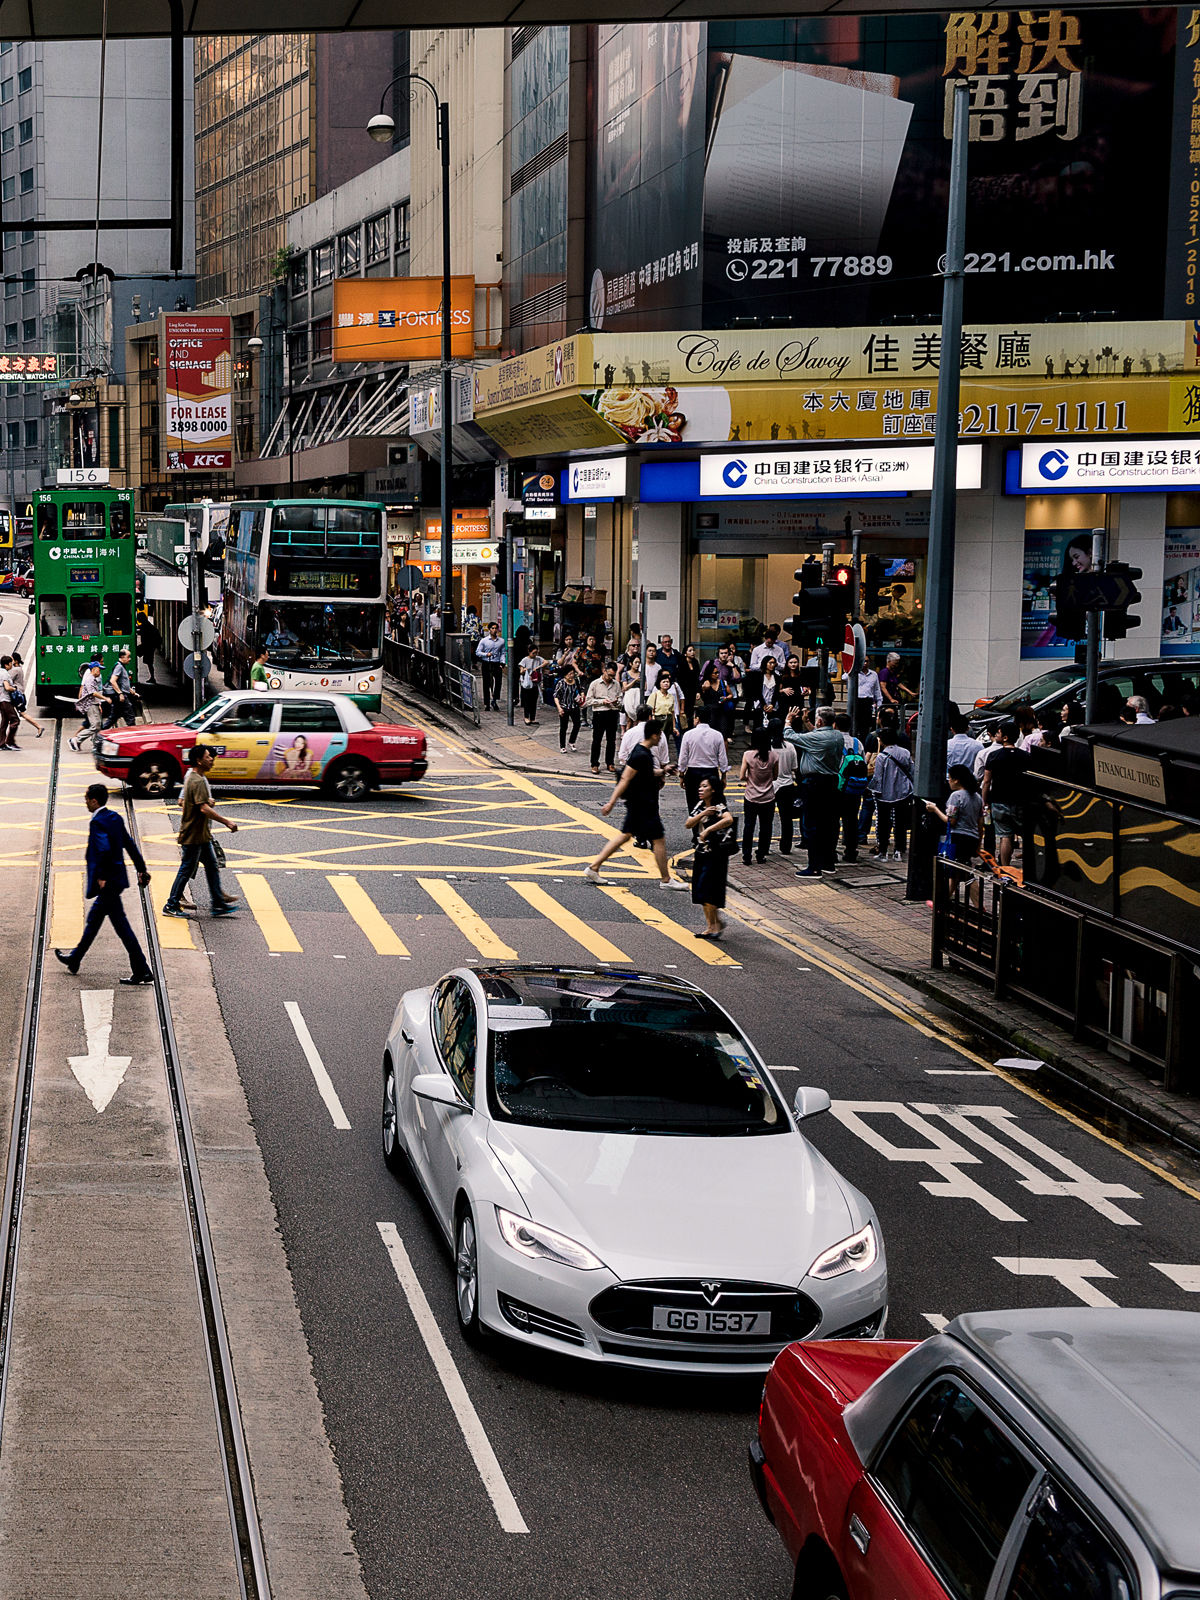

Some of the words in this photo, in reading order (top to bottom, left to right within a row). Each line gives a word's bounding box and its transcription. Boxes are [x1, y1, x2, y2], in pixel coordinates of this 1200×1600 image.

[942, 10, 1083, 77] 解決
[727, 236, 806, 254] 投訴及查詢
[751, 258, 798, 280] 221
[810, 255, 893, 278] 77889
[963, 250, 1115, 273] 221.com.hk
[169, 338, 203, 348] OFFICE
[169, 350, 189, 358] AND
[676, 334, 742, 380] Café
[746, 350, 770, 371] de
[775, 336, 851, 380] Savoy
[862, 330, 1033, 375] 佳美餐廳
[169, 360, 212, 369] SIGNAGE
[803, 389, 931, 413] 本大廈地庫
[171, 407, 192, 419] FOR
[196, 406, 227, 418] LEASE
[964, 400, 1128, 434] 2117-1111
[171, 421, 198, 432] 3898
[200, 420, 227, 432] 0000
[883, 413, 963, 436] 訂座電
[192, 454, 225, 466] KFC
[1077, 449, 1200, 467] 中国建设银
[70, 469, 98, 482] 156
[1077, 468, 1105, 477] China
[1108, 467, 1169, 477] Construction
[1171, 466, 1197, 475] Bank
[754, 477, 778, 486] China
[780, 475, 833, 485] Construction
[834, 475, 857, 484] Bank
[857, 475, 884, 484] (Asia)
[39, 494, 52, 502] 156
[117, 493, 130, 501] 156
[456, 524, 488, 533] FORTRESS
[1097, 760, 1136, 782] FINANCIAL
[1136, 770, 1160, 788] TIMES
[667, 1310, 699, 1331] GG
[705, 1312, 758, 1332] 1537
